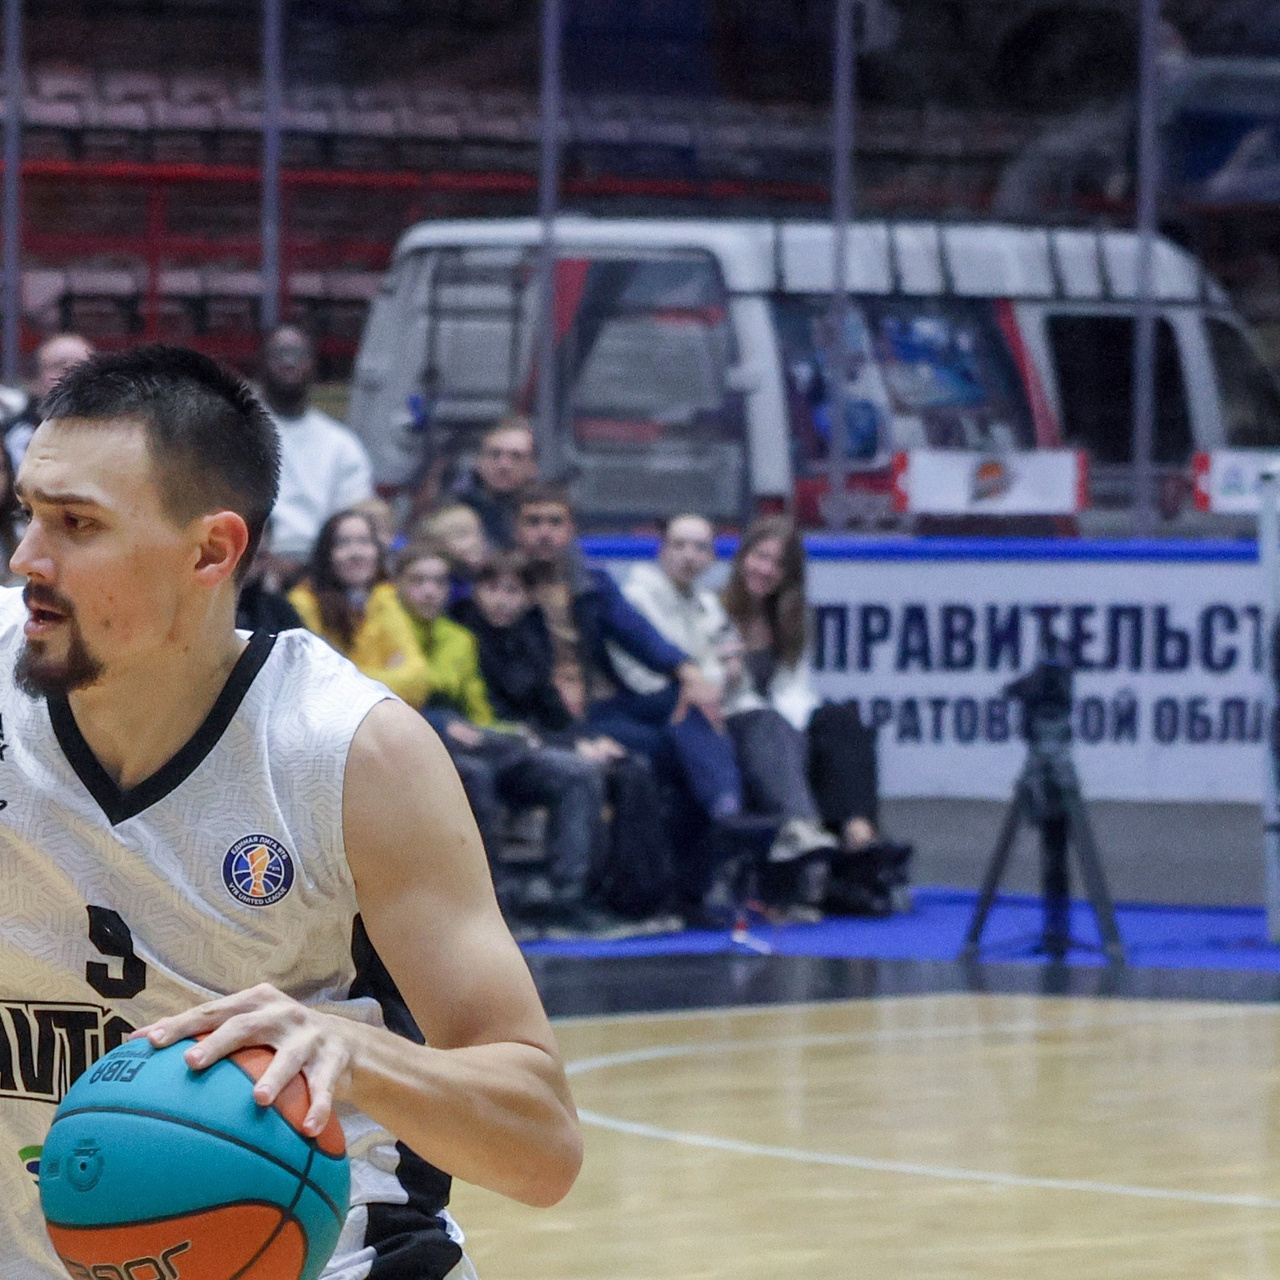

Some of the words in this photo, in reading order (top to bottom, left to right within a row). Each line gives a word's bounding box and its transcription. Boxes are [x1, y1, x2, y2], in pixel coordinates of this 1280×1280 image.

[230, 836, 259, 856] ЕДИНАЯ
[260, 837, 278, 850] ЛИГА
[238, 892, 265, 905] UNITED
[264, 886, 288, 904] LEAGUE
[86, 904, 147, 999] 9
[89, 1060, 147, 1085] FIBA
